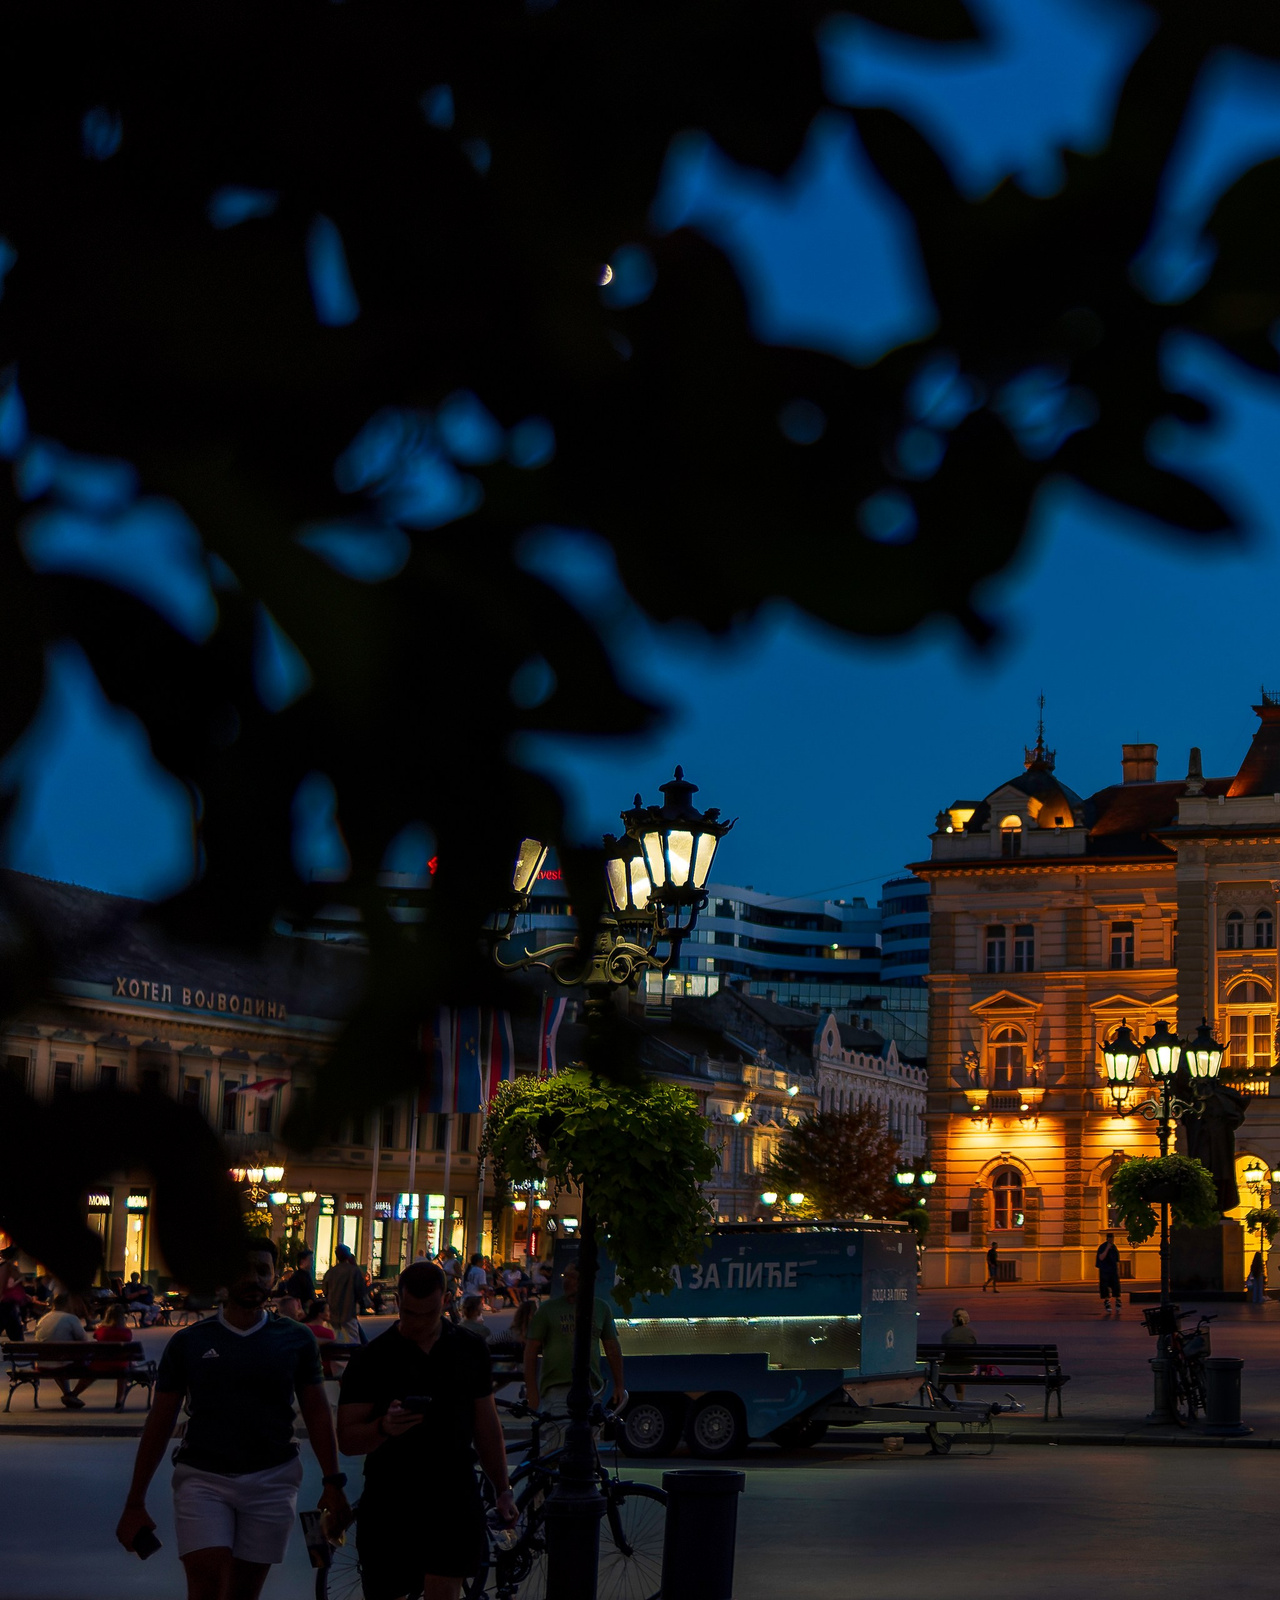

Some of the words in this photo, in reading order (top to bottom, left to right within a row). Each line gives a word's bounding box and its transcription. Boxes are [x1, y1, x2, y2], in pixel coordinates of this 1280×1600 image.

[115, 976, 172, 1003] ХОТЕЛ
[182, 987, 288, 1020] ВОЈВОДИНА
[89, 1195, 110, 1206] MONA
[689, 1262, 721, 1290] ЗА
[727, 1261, 799, 1289] ПИЋЕ
